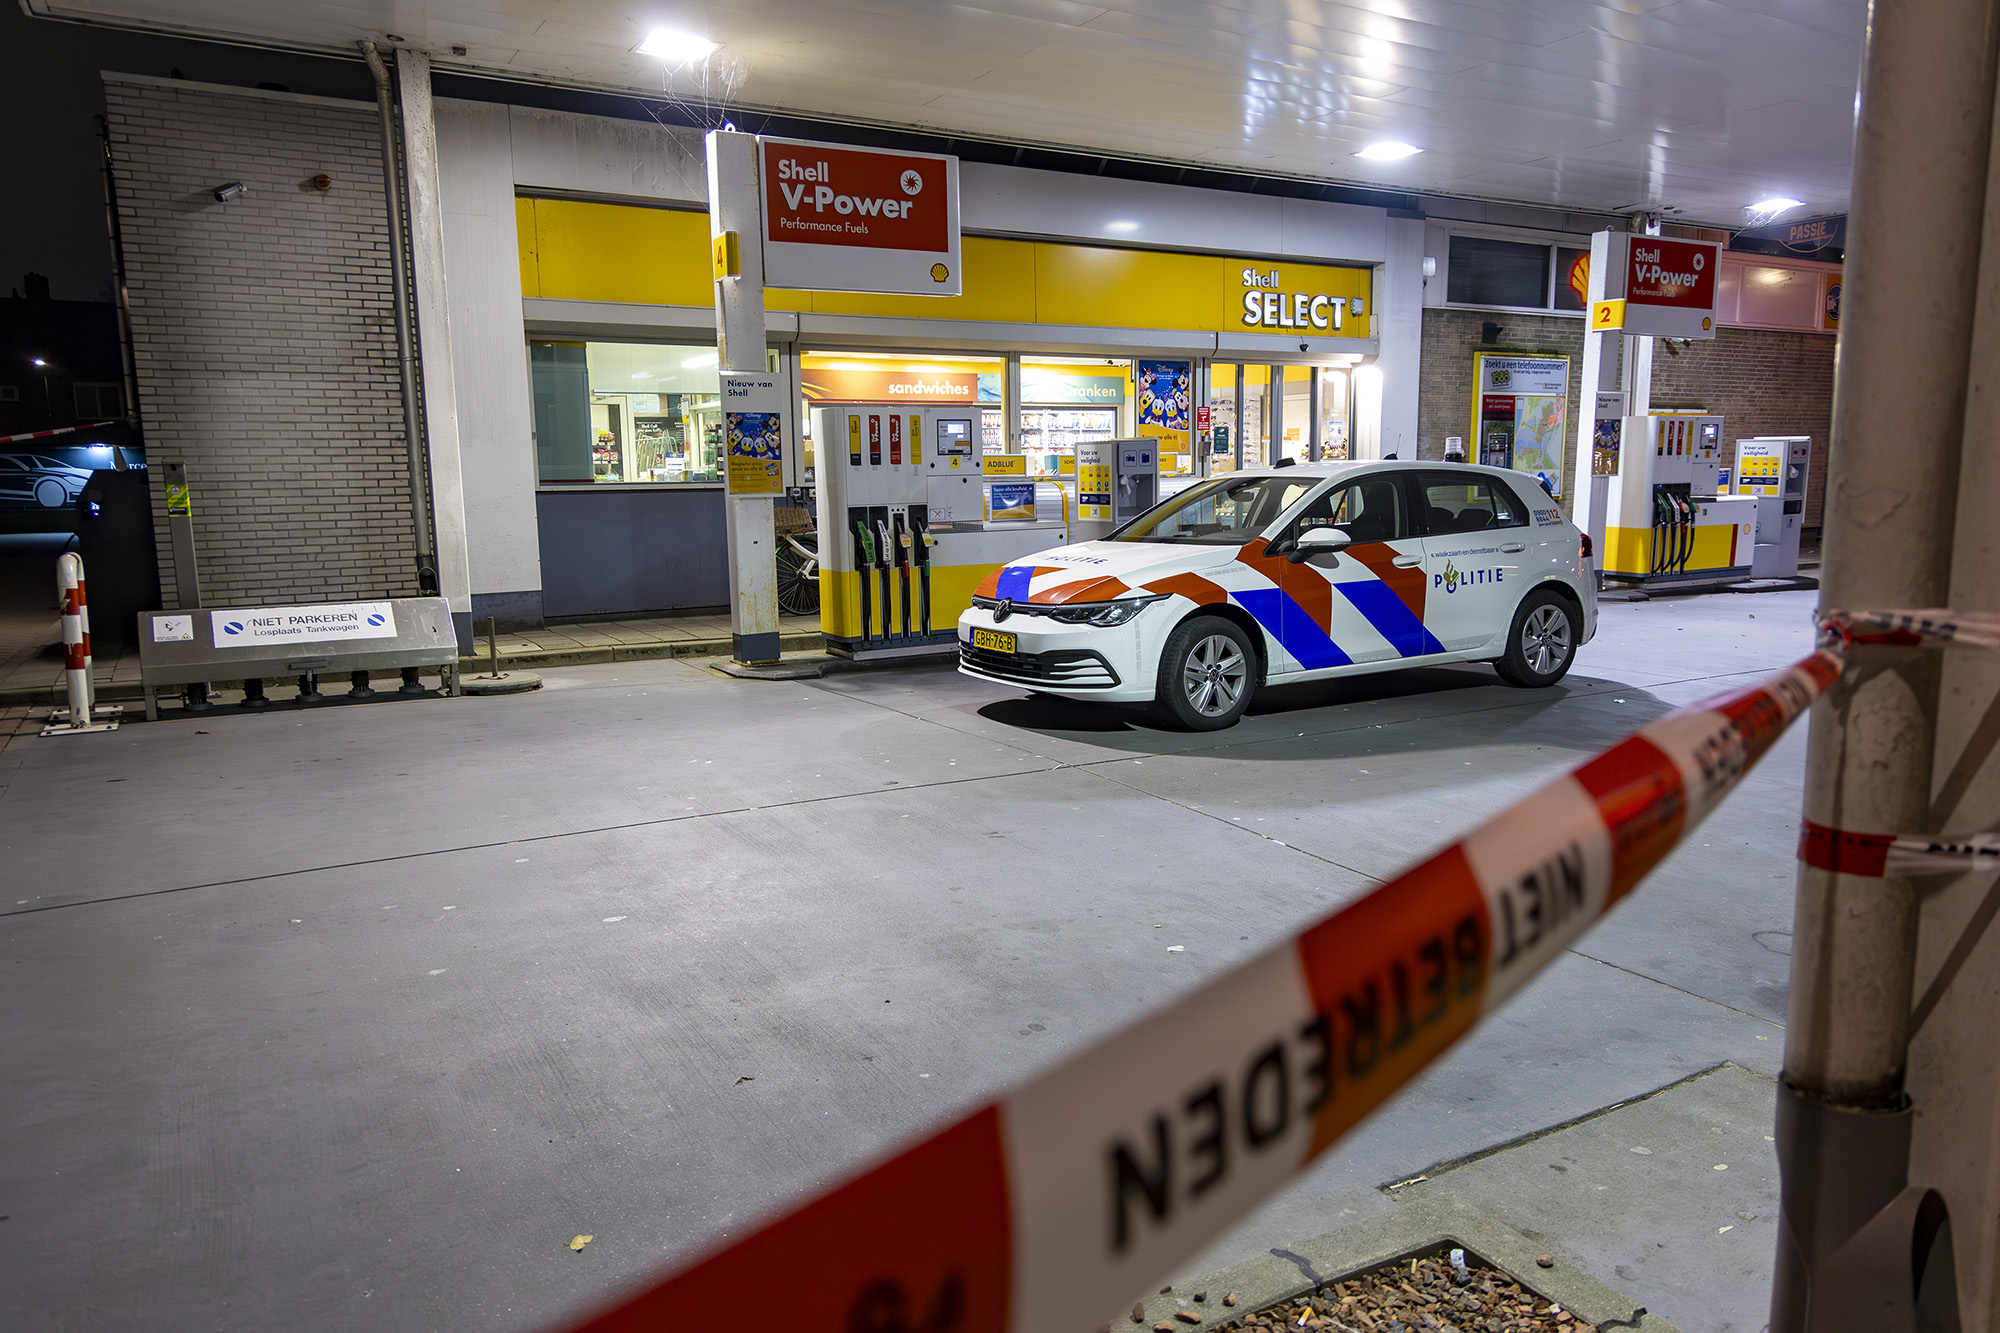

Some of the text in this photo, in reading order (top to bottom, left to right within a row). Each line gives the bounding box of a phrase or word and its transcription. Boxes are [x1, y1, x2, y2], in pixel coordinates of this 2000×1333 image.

[778, 159, 829, 183] Shell
[779, 182, 913, 220] V-Power
[780, 217, 869, 235] Performance Fuels
[1789, 221, 1827, 241] PASSIE
[717, 246, 723, 268] 4
[1635, 248, 1660, 263] Shell
[1242, 268, 1279, 289] Shell
[1635, 263, 1699, 287] V-Power
[1633, 287, 1676, 298] Performance Fuels
[1242, 290, 1346, 330] SELECT
[1600, 306, 1611, 323] 2
[727, 379, 755, 388] Nieuw
[728, 389, 748, 397] Shell
[888, 380, 969, 395] sandwiches
[1546, 509, 1560, 520] 112
[1434, 568, 1504, 594] POLITIE
[252, 613, 358, 627] NIET PARKEREN
[254, 624, 360, 637] Losplaats Tankwagen
[976, 630, 1012, 650] GBH-76-B
[1107, 841, 1586, 1260] NIET BETREDEN
